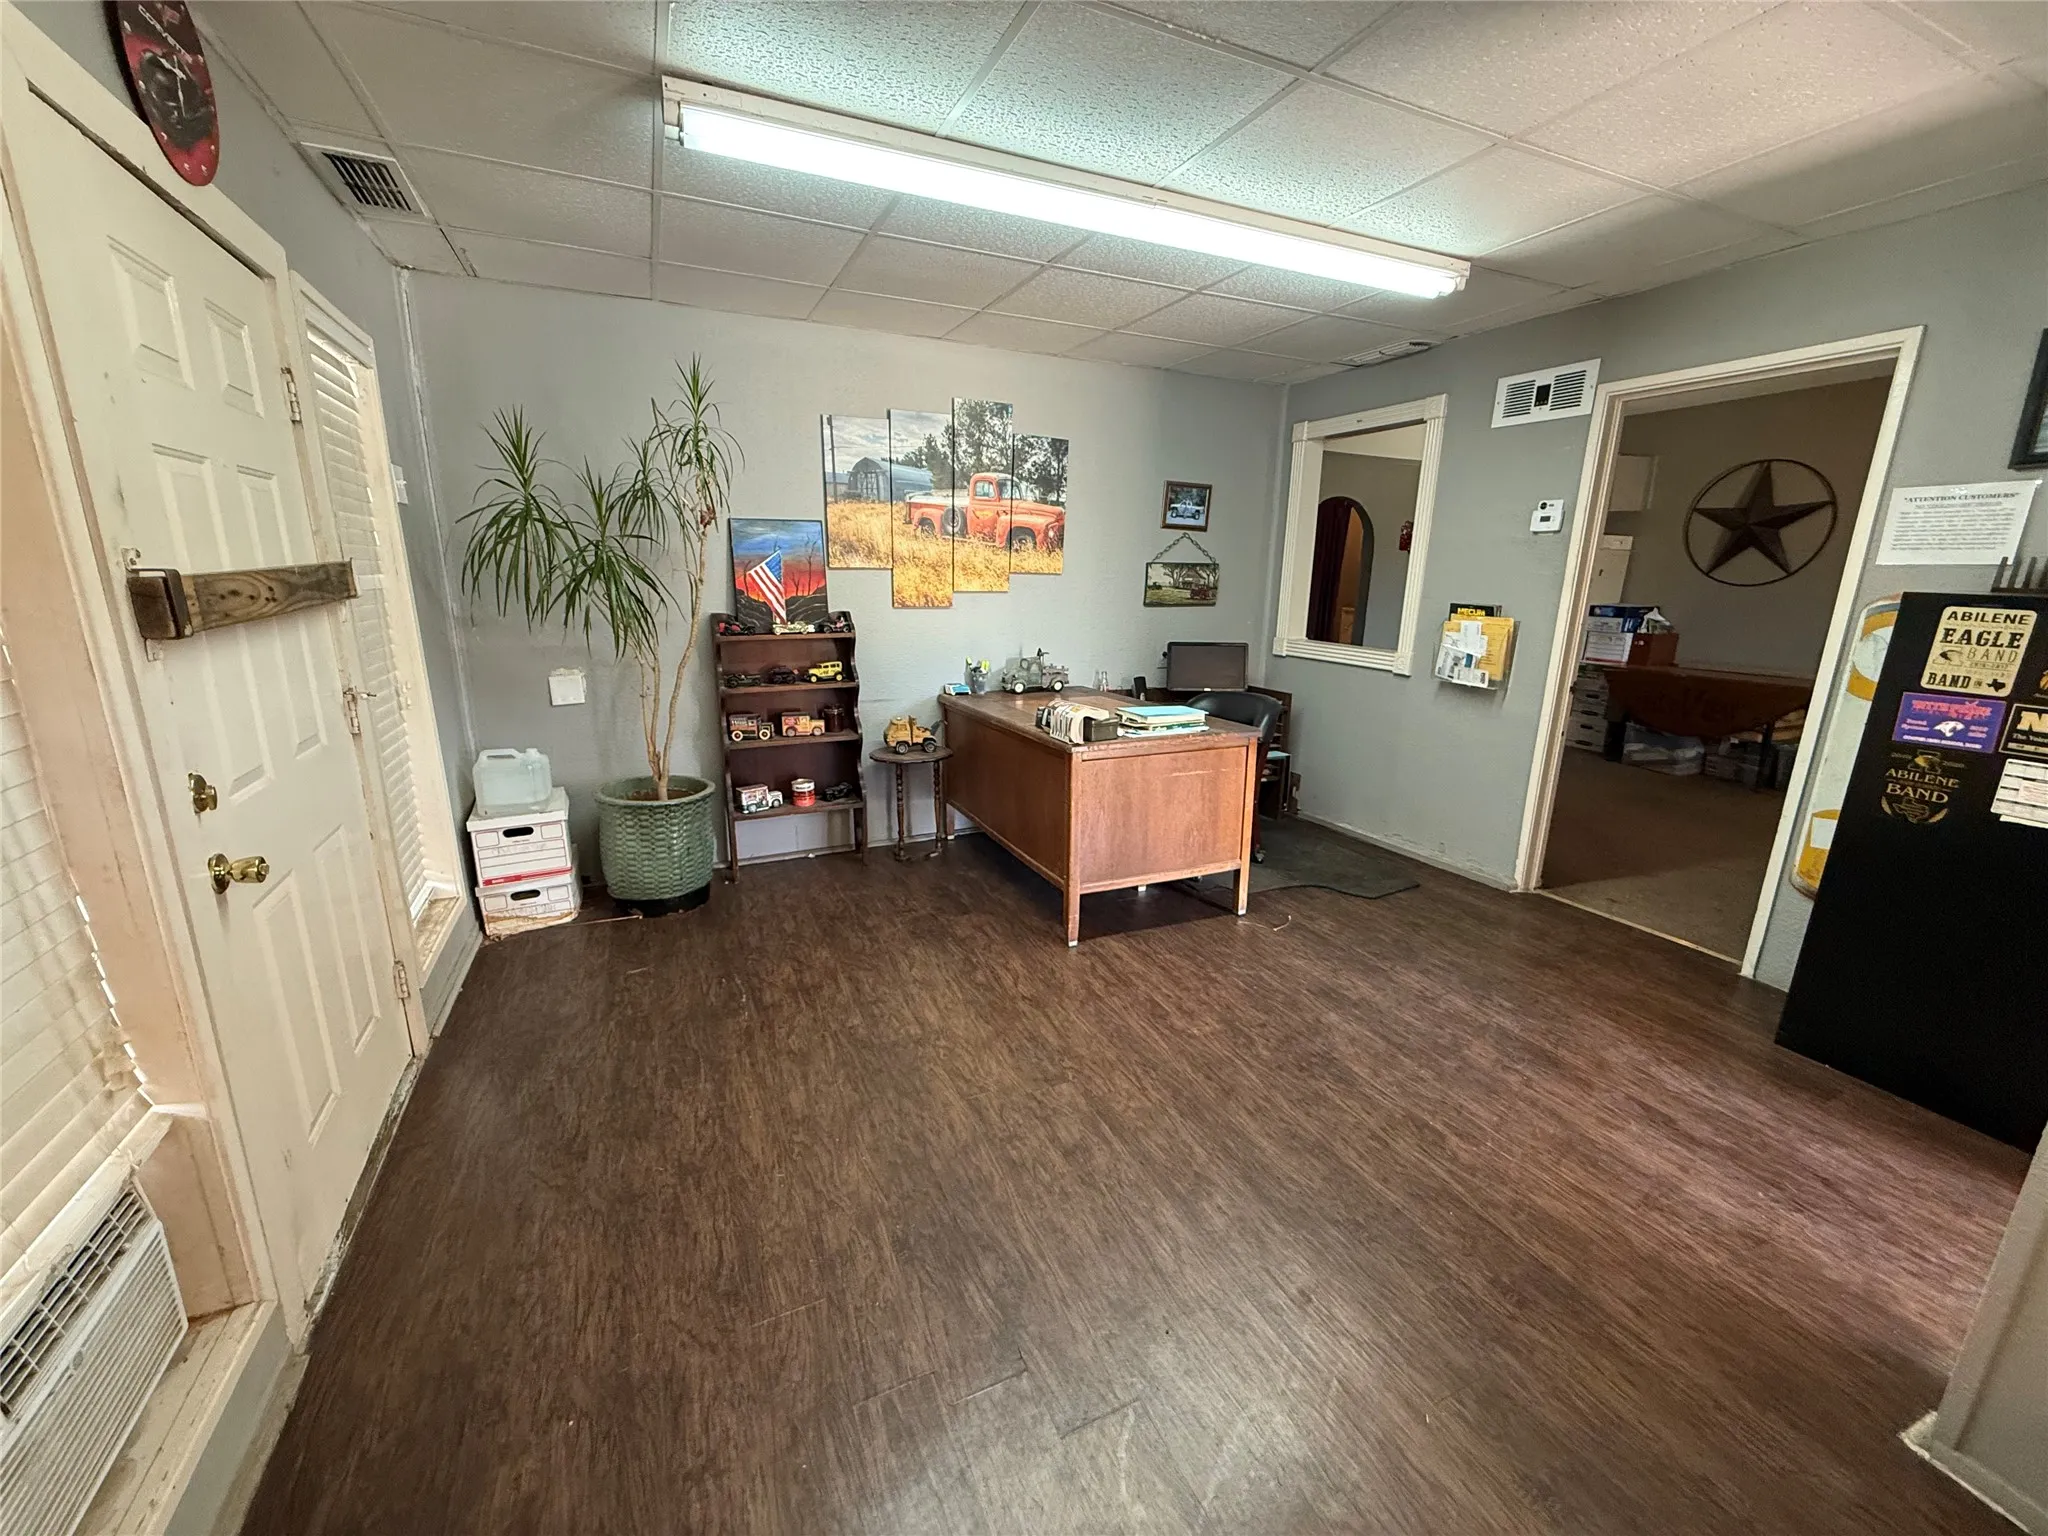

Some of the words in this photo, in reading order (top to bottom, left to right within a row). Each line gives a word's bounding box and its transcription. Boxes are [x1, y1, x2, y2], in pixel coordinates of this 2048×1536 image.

[1457, 607, 1486, 617] MECUM
[1946, 611, 2032, 625] ABILENE
[1940, 627, 2025, 649] EAGLE
[1966, 647, 2018, 663] BAND
[1926, 672, 1971, 689] BAND
[1884, 768, 1960, 789] ABILENE
[1885, 782, 1949, 804] BAND
